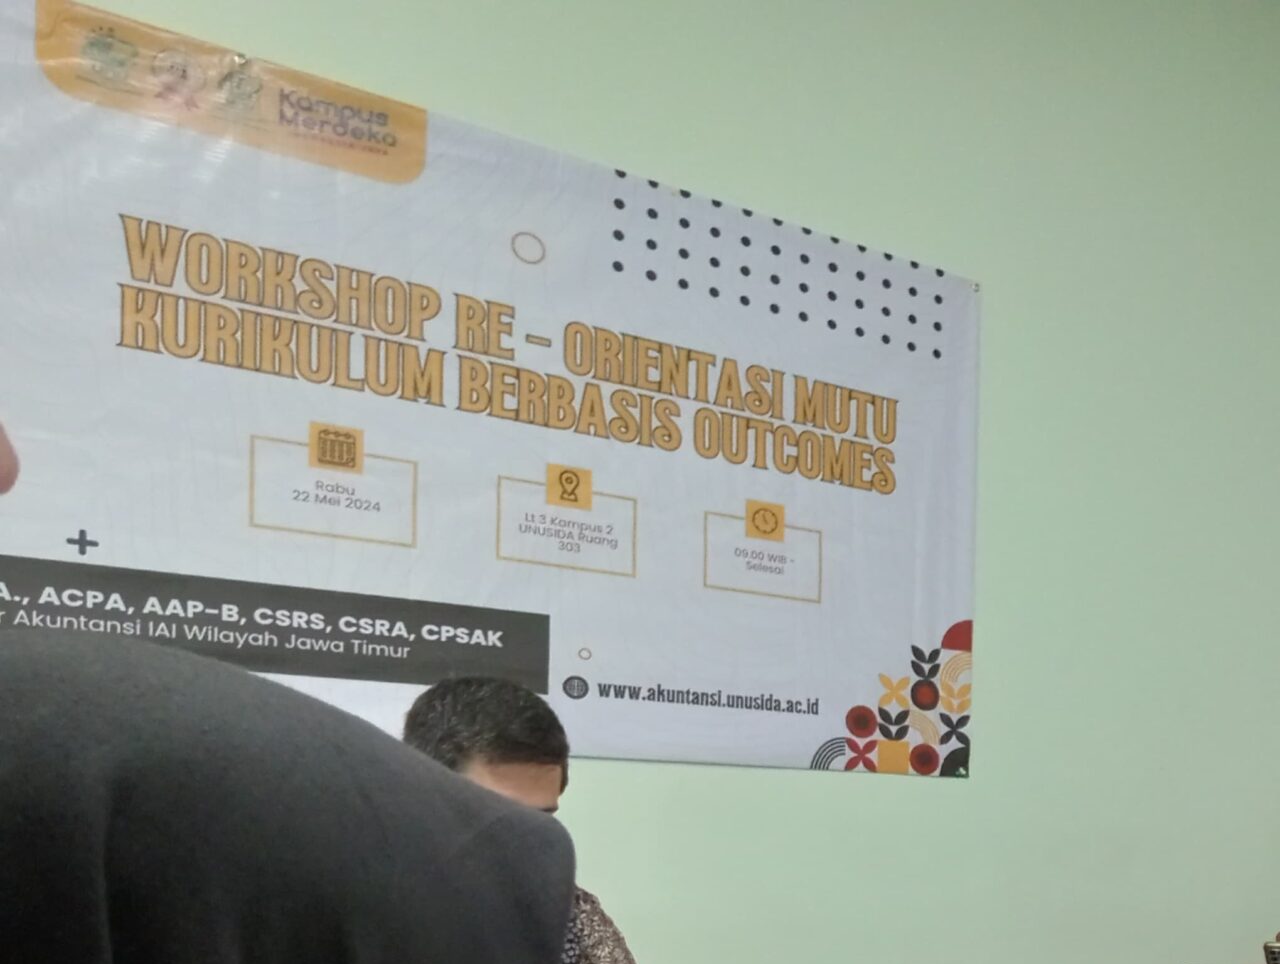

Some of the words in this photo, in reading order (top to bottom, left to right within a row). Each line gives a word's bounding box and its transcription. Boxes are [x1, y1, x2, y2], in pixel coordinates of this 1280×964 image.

[279, 88, 389, 127] Kampus
[278, 107, 397, 148] Merdeka
[118, 213, 442, 341] WORKSHOP
[452, 292, 516, 361] RE
[563, 321, 785, 420] ORIENTASI
[792, 373, 899, 445] MUTU
[116, 282, 447, 408] KURIKULUM
[457, 355, 682, 452] BERBASIS
[692, 406, 897, 496] OUTCOMES
[291, 489, 311, 503] 22
[314, 491, 342, 508] Mei
[345, 496, 381, 514] 2024
[315, 479, 356, 497] Rabu
[518, 523, 575, 543] UNUSIDA
[578, 531, 618, 550] Ruang
[538, 514, 547, 526] 3
[551, 516, 601, 536] Kampus
[604, 523, 614, 535] 2
[558, 540, 581, 554] 303
[733, 547, 765, 563] 09.00
[767, 551, 787, 565] WIB
[745, 559, 785, 576] Selesai
[38, 586, 135, 616] ACPA,
[143, 596, 247, 629] AAP-B,
[253, 606, 332, 634] CSRS,
[338, 616, 417, 643] CSRA,
[421, 623, 504, 649] CPSAK
[13, 609, 142, 636] Akuntansi
[148, 620, 177, 639] IAI
[183, 624, 279, 651] Wilayah
[284, 633, 345, 655] Jawa
[350, 639, 412, 660] Timur
[597, 681, 820, 716] www.akuntansi.unusida.ac.id
